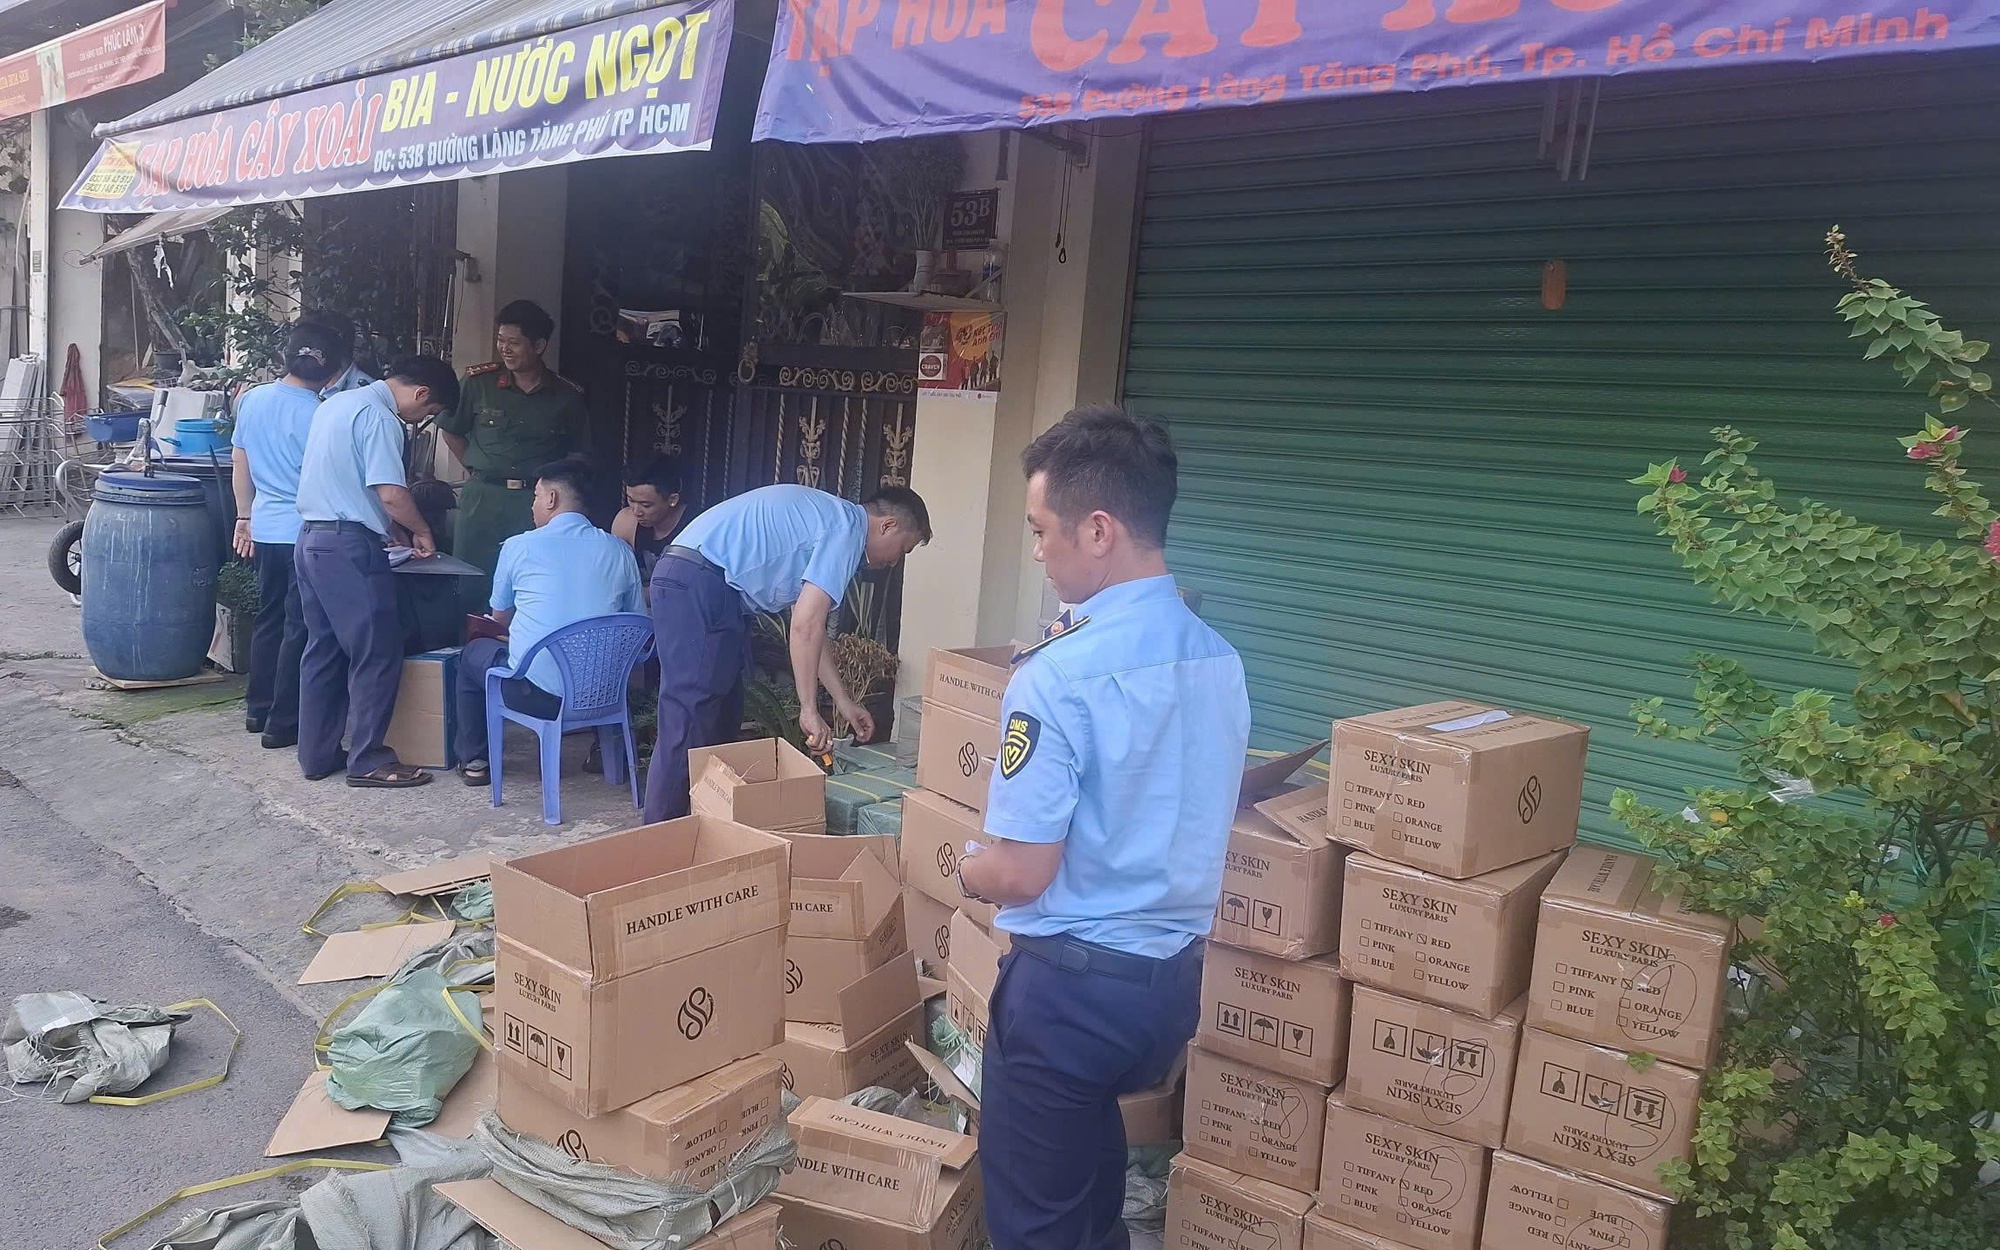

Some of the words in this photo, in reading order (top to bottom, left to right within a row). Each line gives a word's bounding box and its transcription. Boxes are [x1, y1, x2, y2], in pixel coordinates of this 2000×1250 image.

[1199, 72, 1285, 102] Làng
[1300, 61, 1397, 92] Tăng
[1520, 42, 1586, 77] Tp.
[1695, 17, 1792, 58] Chí
[1804, 7, 1949, 49] Minh
[380, 71, 437, 132] BIA
[465, 35, 576, 118] NƯỚC
[585, 10, 712, 99] NGỌT
[177, 112, 233, 192] HÓA
[236, 98, 301, 183] CÂY
[398, 146, 424, 171] 53B
[427, 135, 478, 167] ĐƯỜNG
[482, 127, 526, 159] LÀNG
[574, 112, 610, 144] PHÚ
[611, 112, 635, 138] TP
[639, 102, 691, 135] HCM
[939, 673, 969, 690] HANDLE
[970, 682, 991, 697] WITH
[1364, 749, 1398, 768] SEXY
[1399, 757, 1432, 775] SKIN
[1356, 784, 1392, 801] TIFFANY
[1355, 802, 1376, 814] PINK
[1407, 797, 1425, 809] RED
[1296, 806, 1327, 823] HANDL
[1354, 820, 1375, 832] BLUE
[1405, 815, 1442, 832] ORANGE
[1403, 833, 1441, 850] YELLOW
[1241, 854, 1271, 871] SKIN
[790, 902, 803, 911] TH
[805, 902, 834, 913] CARE
[1382, 887, 1419, 907] SEXY
[1422, 897, 1458, 915] SKIN
[626, 907, 683, 936] HANDLE
[685, 896, 723, 917] WITH
[725, 885, 759, 904] CARE
[1389, 902, 1424, 916] LUXURY
[1424, 910, 1449, 923] PARIS
[1373, 922, 1414, 940] TIFFANY
[1372, 940, 1395, 953] PINK
[1431, 937, 1451, 949] RED
[1582, 930, 1626, 949] SEXY
[1628, 940, 1671, 960] SKIN
[1371, 958, 1395, 971] BLUE
[1428, 956, 1471, 973] ORANGE
[1590, 946, 1630, 962] LUXURY
[1631, 954, 1659, 968] PARIS
[1234, 967, 1267, 984] SEXY
[1270, 976, 1301, 993] SKIN
[1427, 973, 1469, 991] YELLOW
[1571, 966, 1617, 985] TIFFANY
[514, 972, 538, 995] SEXY
[539, 984, 561, 1005] SKIN
[1241, 980, 1271, 995] LUXURY
[1272, 989, 1293, 1000] PARIS
[1568, 985, 1596, 999] PINK
[1566, 1004, 1594, 1017] BLUE
[1634, 1002, 1682, 1021] ORANGE
[1632, 1020, 1680, 1039] YELLOW
[1220, 1072, 1253, 1089] SEXY
[1386, 1085, 1421, 1105] SKIN
[741, 1103, 759, 1119] BLUE
[1423, 1096, 1462, 1115] SEXY
[828, 1112, 859, 1127] CARE
[1211, 1120, 1232, 1132] PINK
[1264, 1120, 1281, 1131] RED
[685, 1126, 717, 1150] YELLOW
[741, 1121, 759, 1138] PINK
[860, 1122, 893, 1137] WITH
[1562, 1124, 1588, 1140] PARIS
[898, 1133, 947, 1149] HANDLE
[1211, 1135, 1232, 1148] BLUE
[1262, 1136, 1298, 1152] ORANGE
[1365, 1132, 1402, 1152] SEXY
[1405, 1146, 1440, 1164] SKIN
[1553, 1131, 1591, 1153] SKIN
[1589, 1135, 1629, 1151] LUXURY
[685, 1145, 716, 1168] ORANGE
[1260, 1151, 1296, 1168] YELLOW
[1372, 1148, 1406, 1164] LUXURY
[1407, 1159, 1430, 1171] PARIS
[1593, 1148, 1637, 1167] SEXY
[700, 1165, 718, 1178] RED
[795, 1157, 828, 1173] NDLE
[831, 1164, 865, 1182] WITH
[867, 1173, 900, 1191] CARE
[1357, 1165, 1396, 1185] TIFFANY
[1355, 1183, 1378, 1196] PINK
[1413, 1184, 1433, 1196] RED
[1510, 1184, 1554, 1204] YELLOW
[1199, 1193, 1231, 1214] SEXY
[1233, 1204, 1264, 1227] SKIN
[1354, 1199, 1378, 1212] BLUE
[1411, 1201, 1452, 1220] ORANGE
[1508, 1201, 1551, 1222] ORANGE
[1205, 1208, 1234, 1225] LUXURY
[1590, 1209, 1617, 1224] BLUE
[1192, 1223, 1226, 1244] TIFFANY
[1410, 1217, 1451, 1236] YELLOW
[1527, 1226, 1549, 1239] RED
[1588, 1228, 1615, 1243] PINK
